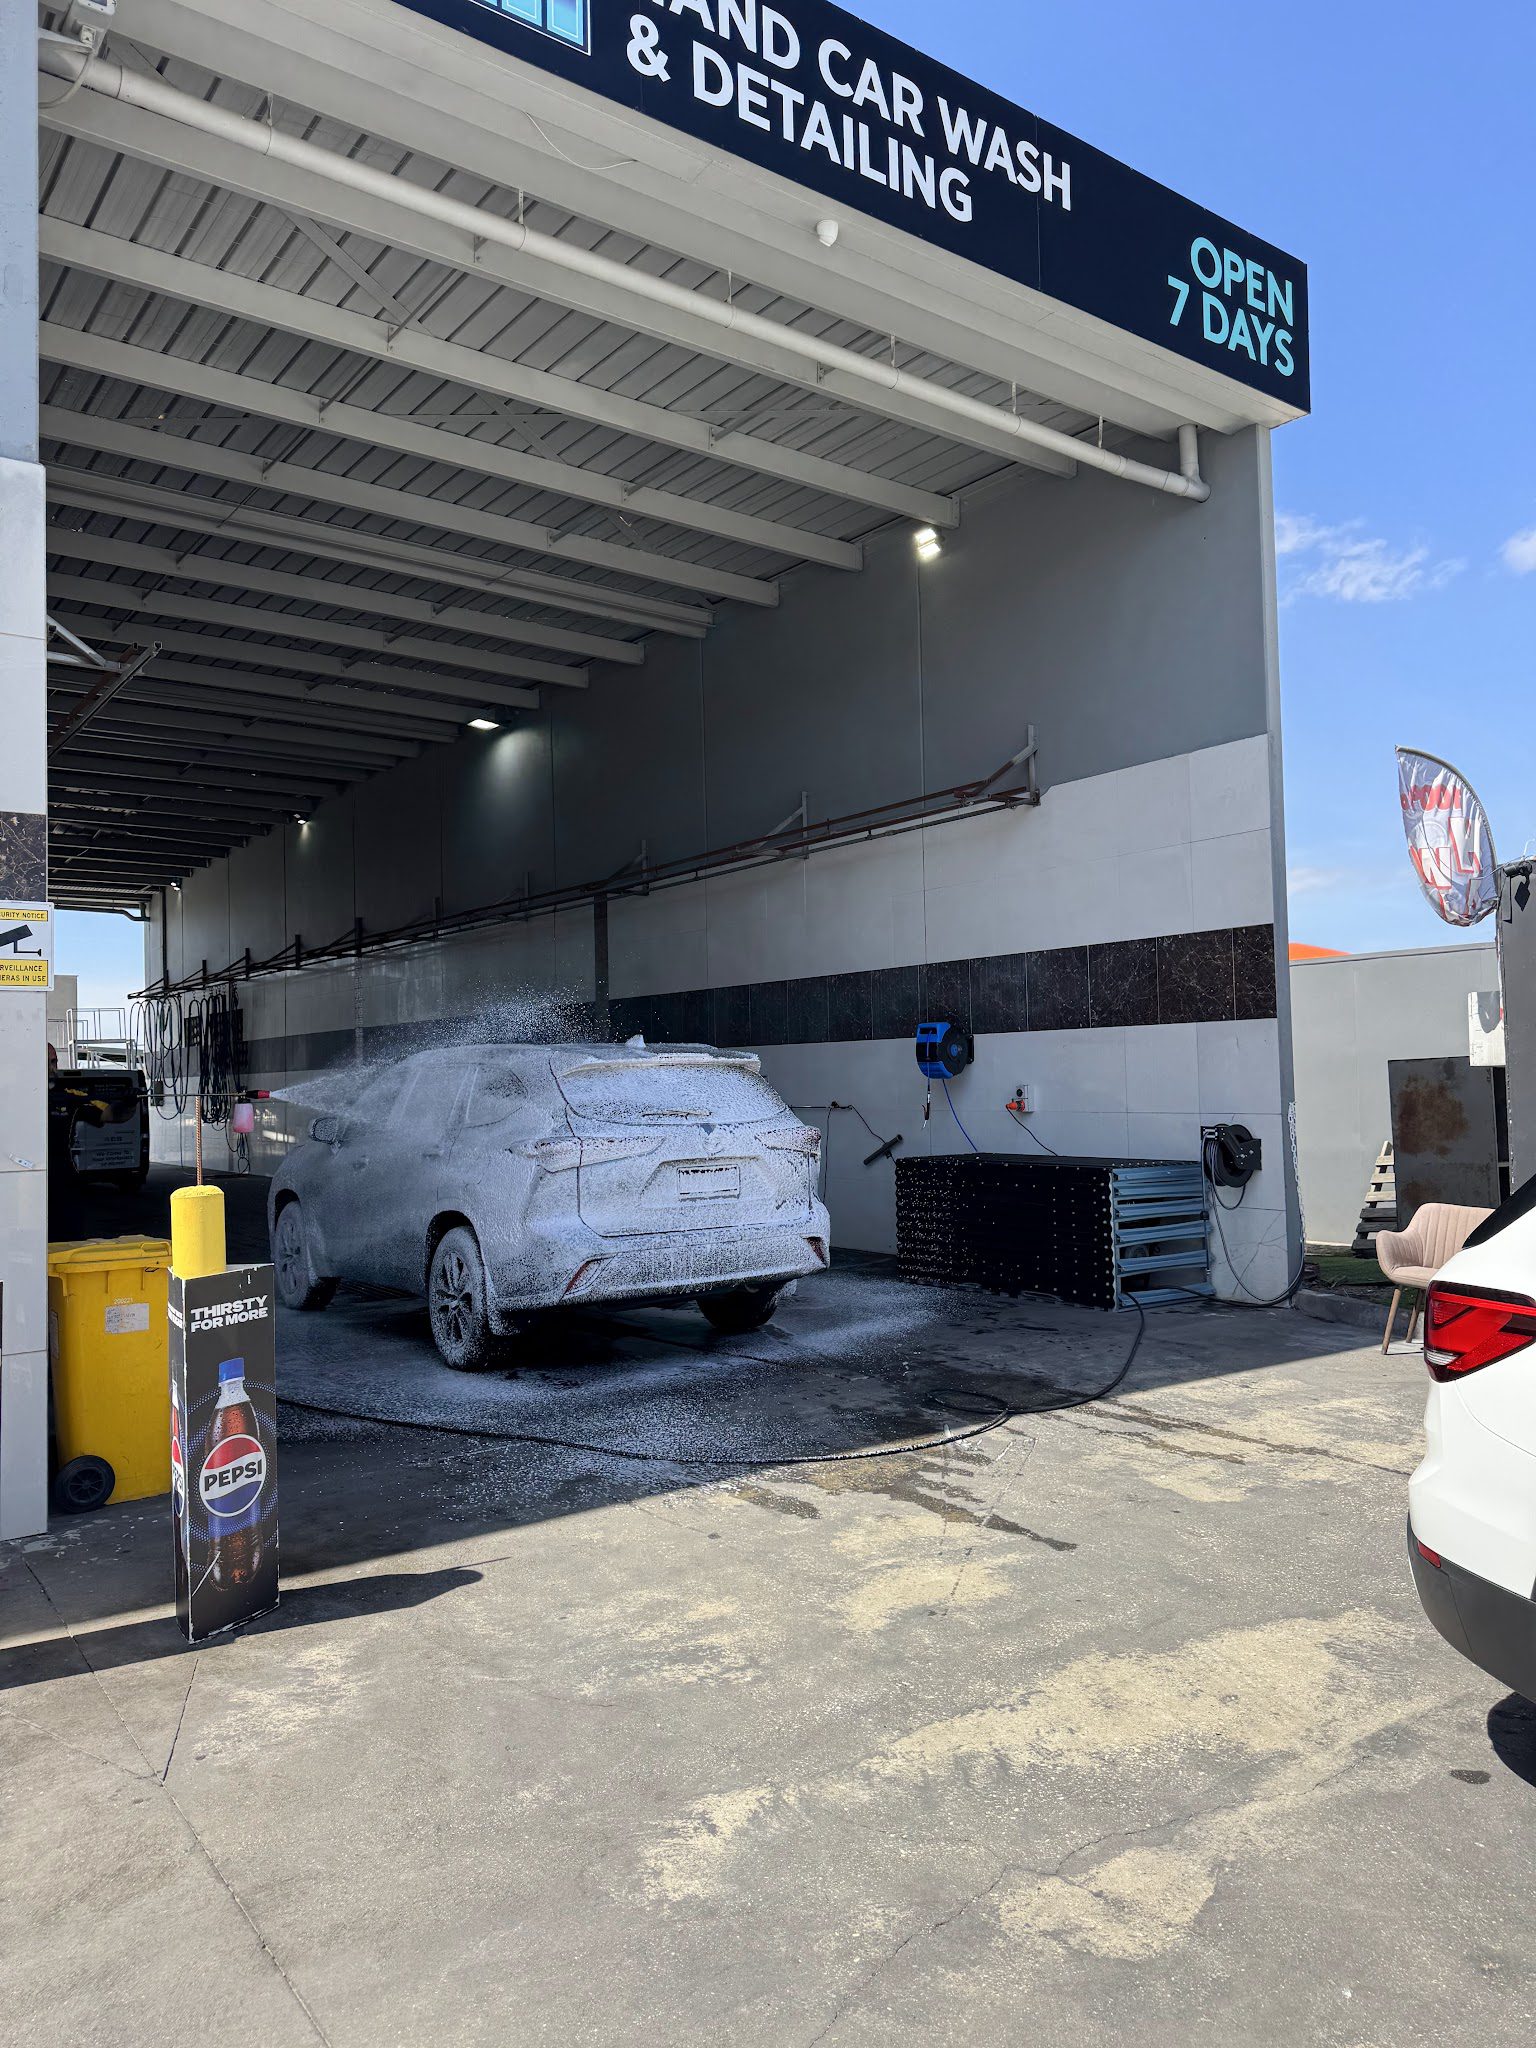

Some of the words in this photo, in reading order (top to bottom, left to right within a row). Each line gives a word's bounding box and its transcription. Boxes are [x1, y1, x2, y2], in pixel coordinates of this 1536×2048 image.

[627, 14, 671, 83] &
[693, 40, 973, 223] DETAILING
[652, 0, 800, 70] AND
[818, 39, 925, 138] CAR
[937, 95, 1071, 212] WASH
[1190, 236, 1294, 327] OPEN
[1167, 274, 1190, 327] 7
[1202, 290, 1295, 377] DAYS
[0, 911, 20, 919] URITY
[0, 974, 21, 982] ERAS
[190, 1294, 268, 1321] THIRSTY
[190, 1319, 223, 1333] FOR
[225, 1307, 269, 1326] MORE
[204, 1459, 263, 1492] PEPSI
